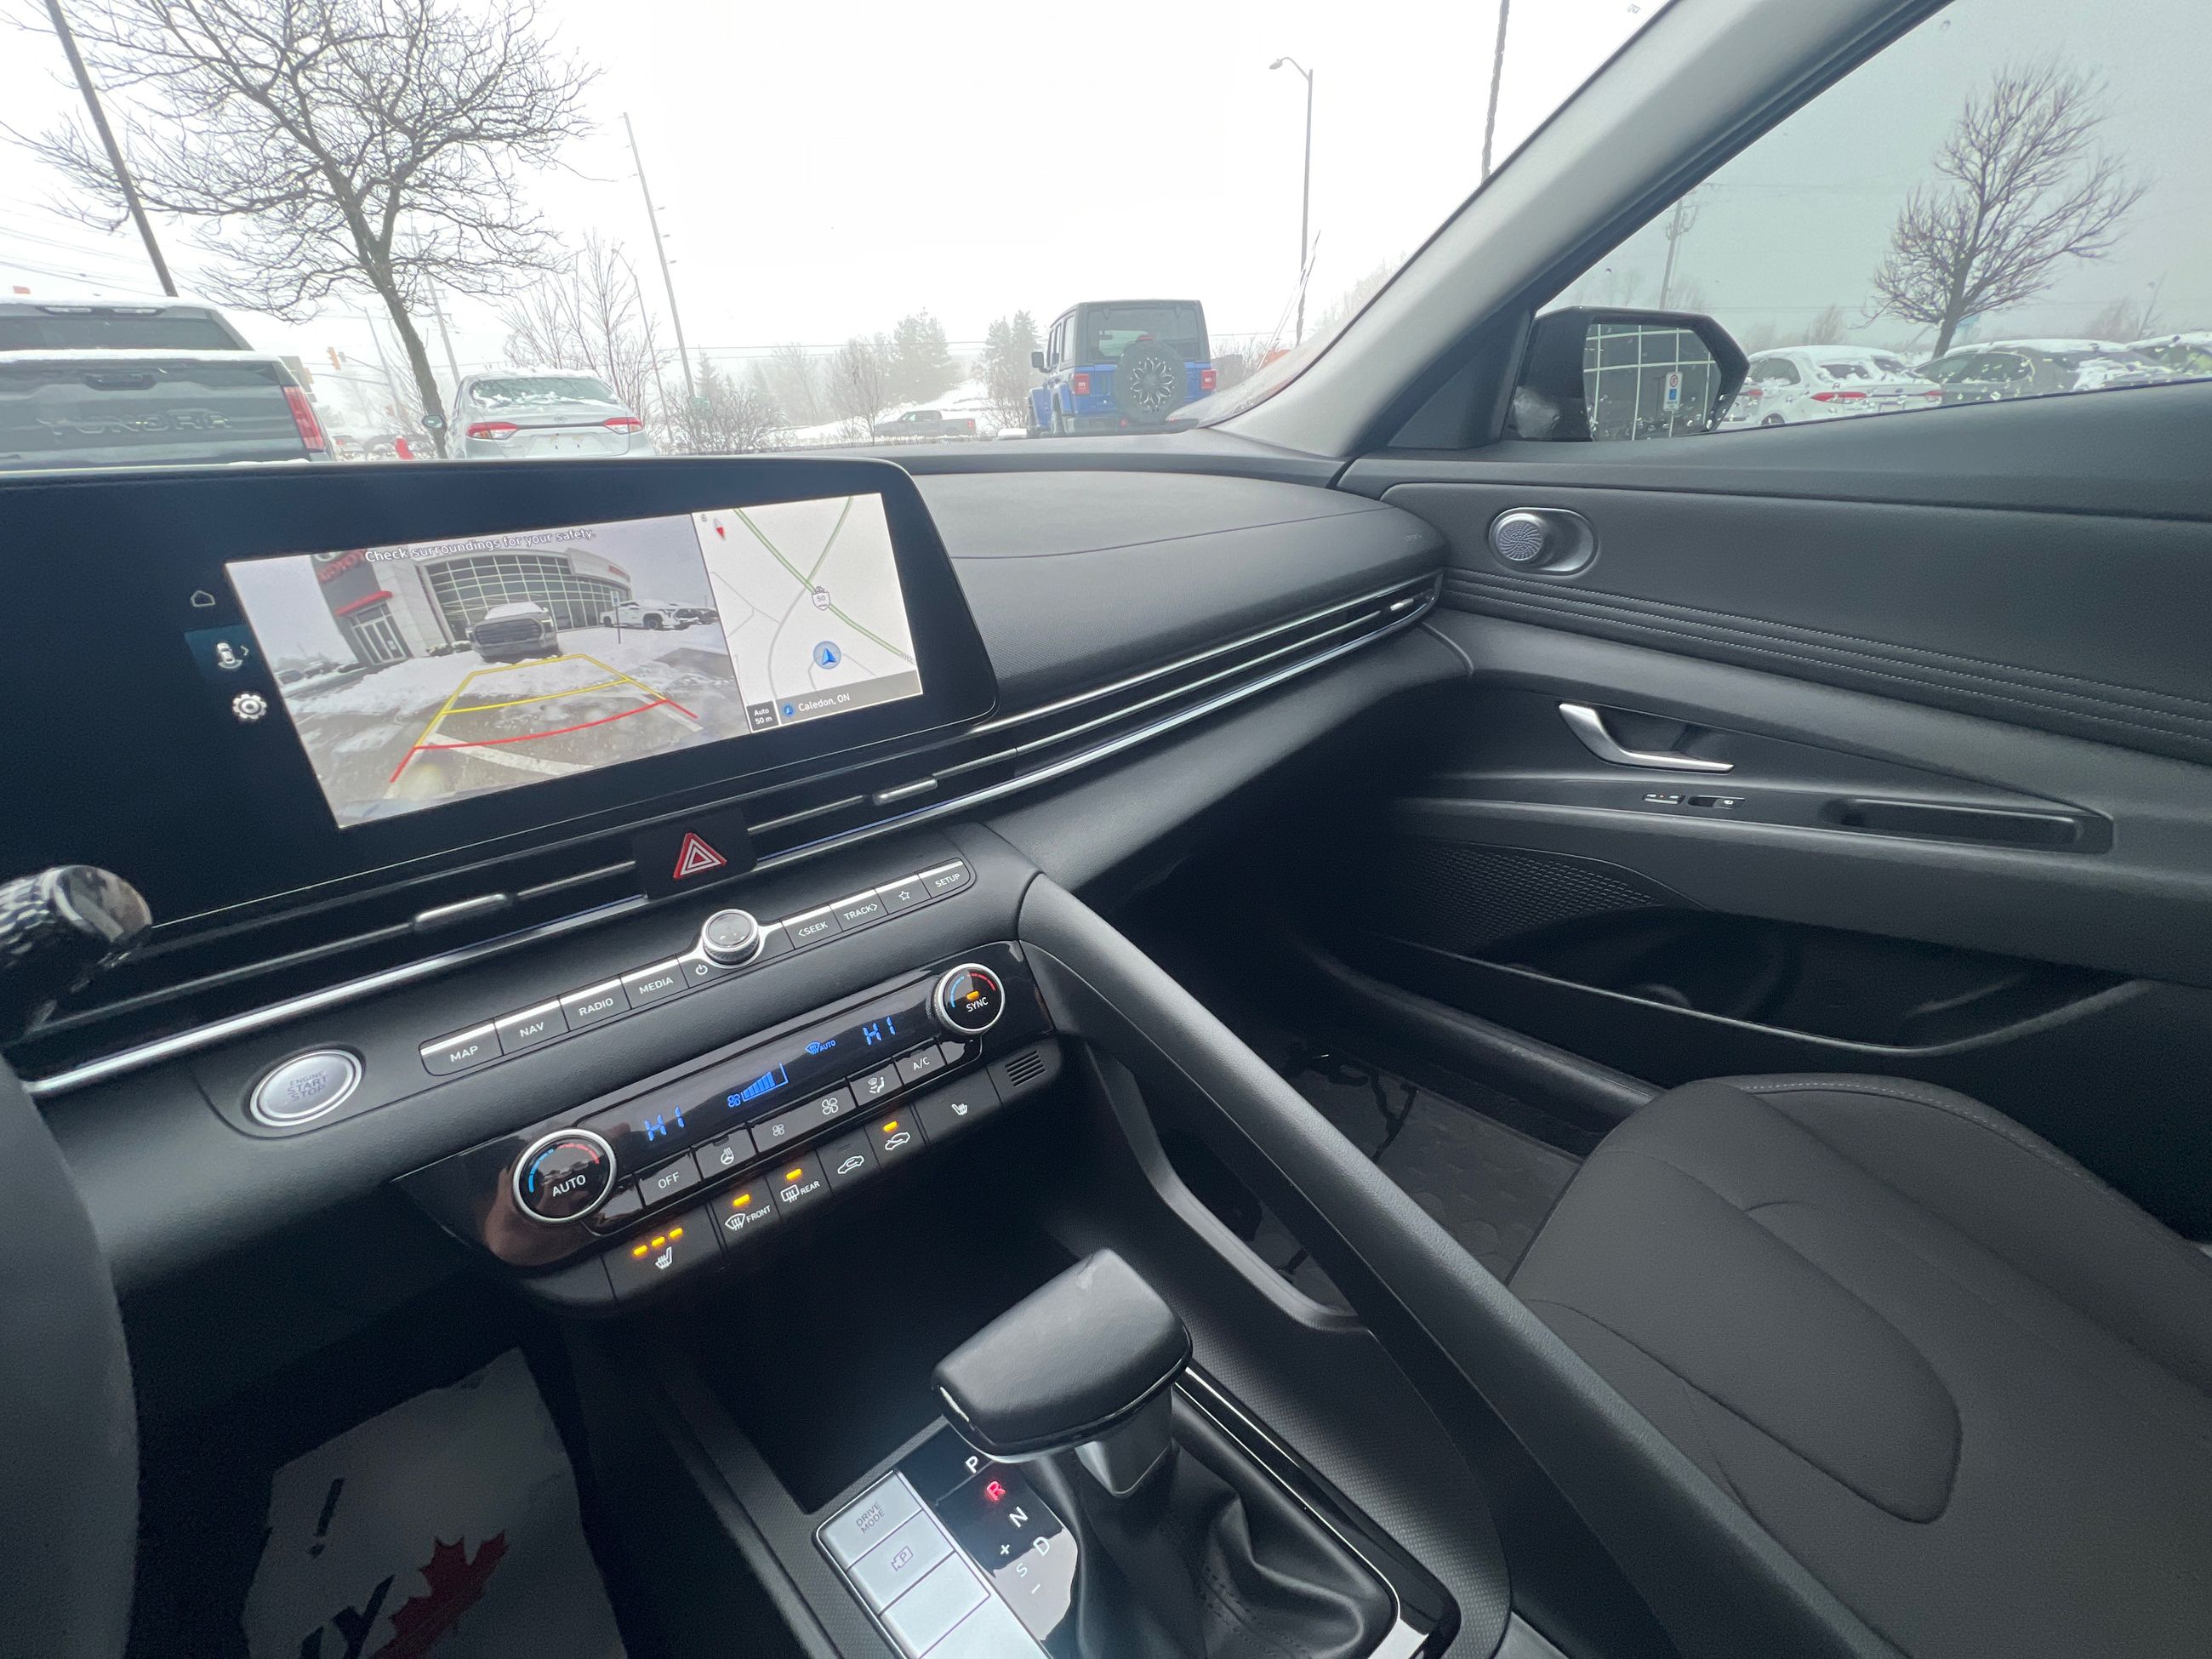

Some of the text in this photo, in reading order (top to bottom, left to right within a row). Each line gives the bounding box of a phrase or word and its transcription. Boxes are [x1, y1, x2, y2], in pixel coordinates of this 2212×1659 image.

[364, 547, 409, 563] Check
[411, 539, 501, 558] surroundings
[503, 536, 522, 547] for
[523, 534, 552, 547] your
[836, 693, 851, 704] ON
[754, 707, 770, 716] Auto
[935, 872, 961, 888] SETUP
[639, 977, 674, 995] MEDIA
[579, 997, 614, 1016] RADIO
[966, 996, 989, 1012] SYNC
[519, 1022, 544, 1038] NAV
[862, 1016, 896, 1046] HI
[449, 1045, 479, 1063] MAP
[819, 1040, 836, 1052] AUTO
[913, 1056, 930, 1071] A/C
[287, 1075, 328, 1095] START
[291, 1083, 327, 1101] STOP
[643, 1106, 685, 1142] HI
[552, 1174, 587, 1197] AUTO
[658, 1172, 680, 1189] OFF
[800, 1180, 820, 1195] REAR
[746, 1205, 772, 1223] FRONT
[965, 1456, 979, 1474] P
[986, 1480, 1006, 1502] R
[855, 1501, 882, 1526] DRIVE
[860, 1508, 886, 1534] MODE
[1008, 1506, 1029, 1528] N
[1032, 1536, 1050, 1556] D
[1016, 1563, 1029, 1577] S
